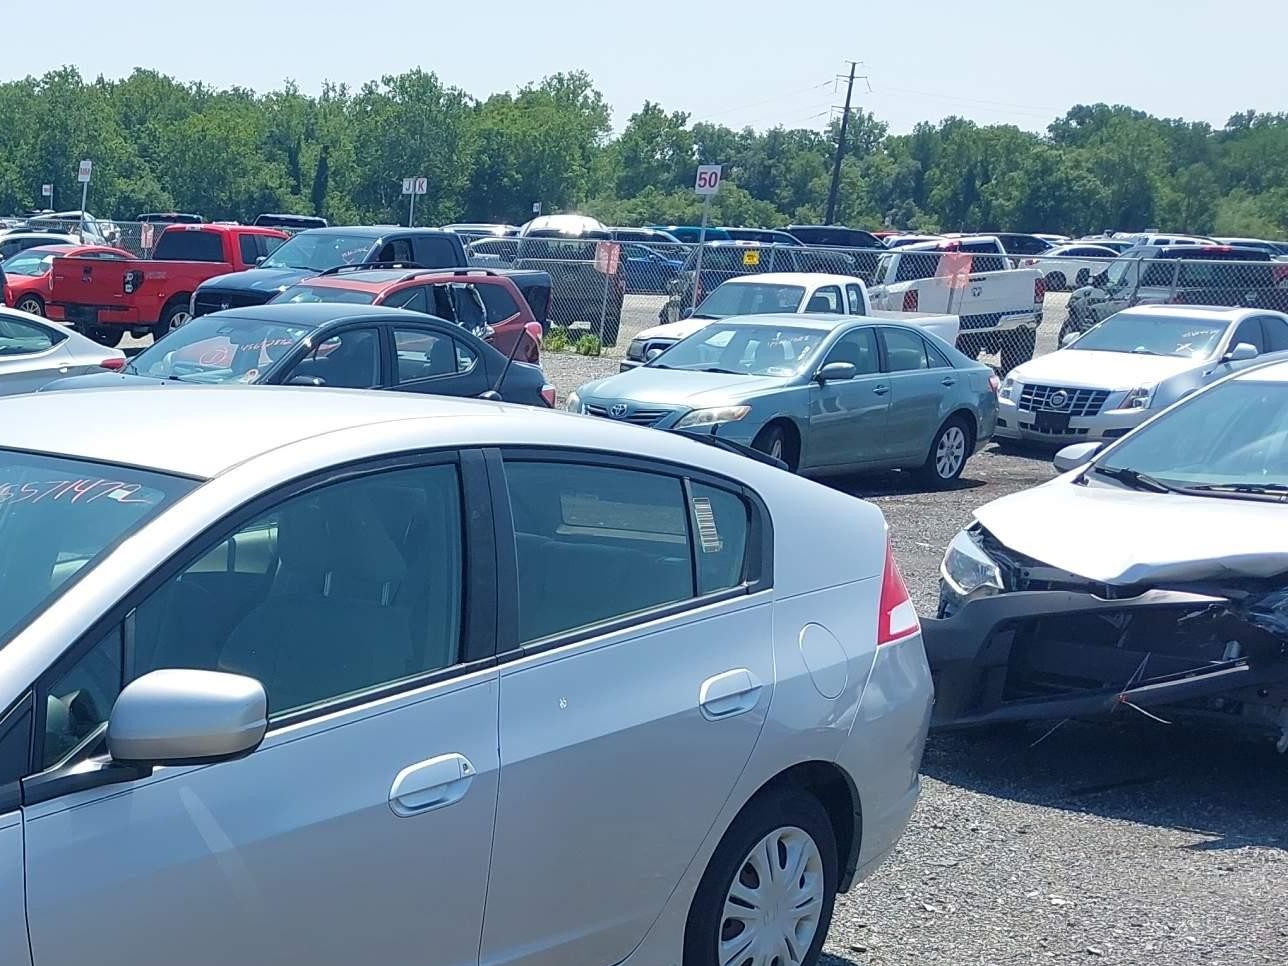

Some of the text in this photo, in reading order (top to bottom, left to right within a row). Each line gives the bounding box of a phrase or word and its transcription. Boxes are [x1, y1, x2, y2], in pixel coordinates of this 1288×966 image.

[405, 181, 425, 191] J K
[698, 171, 718, 188] 50
